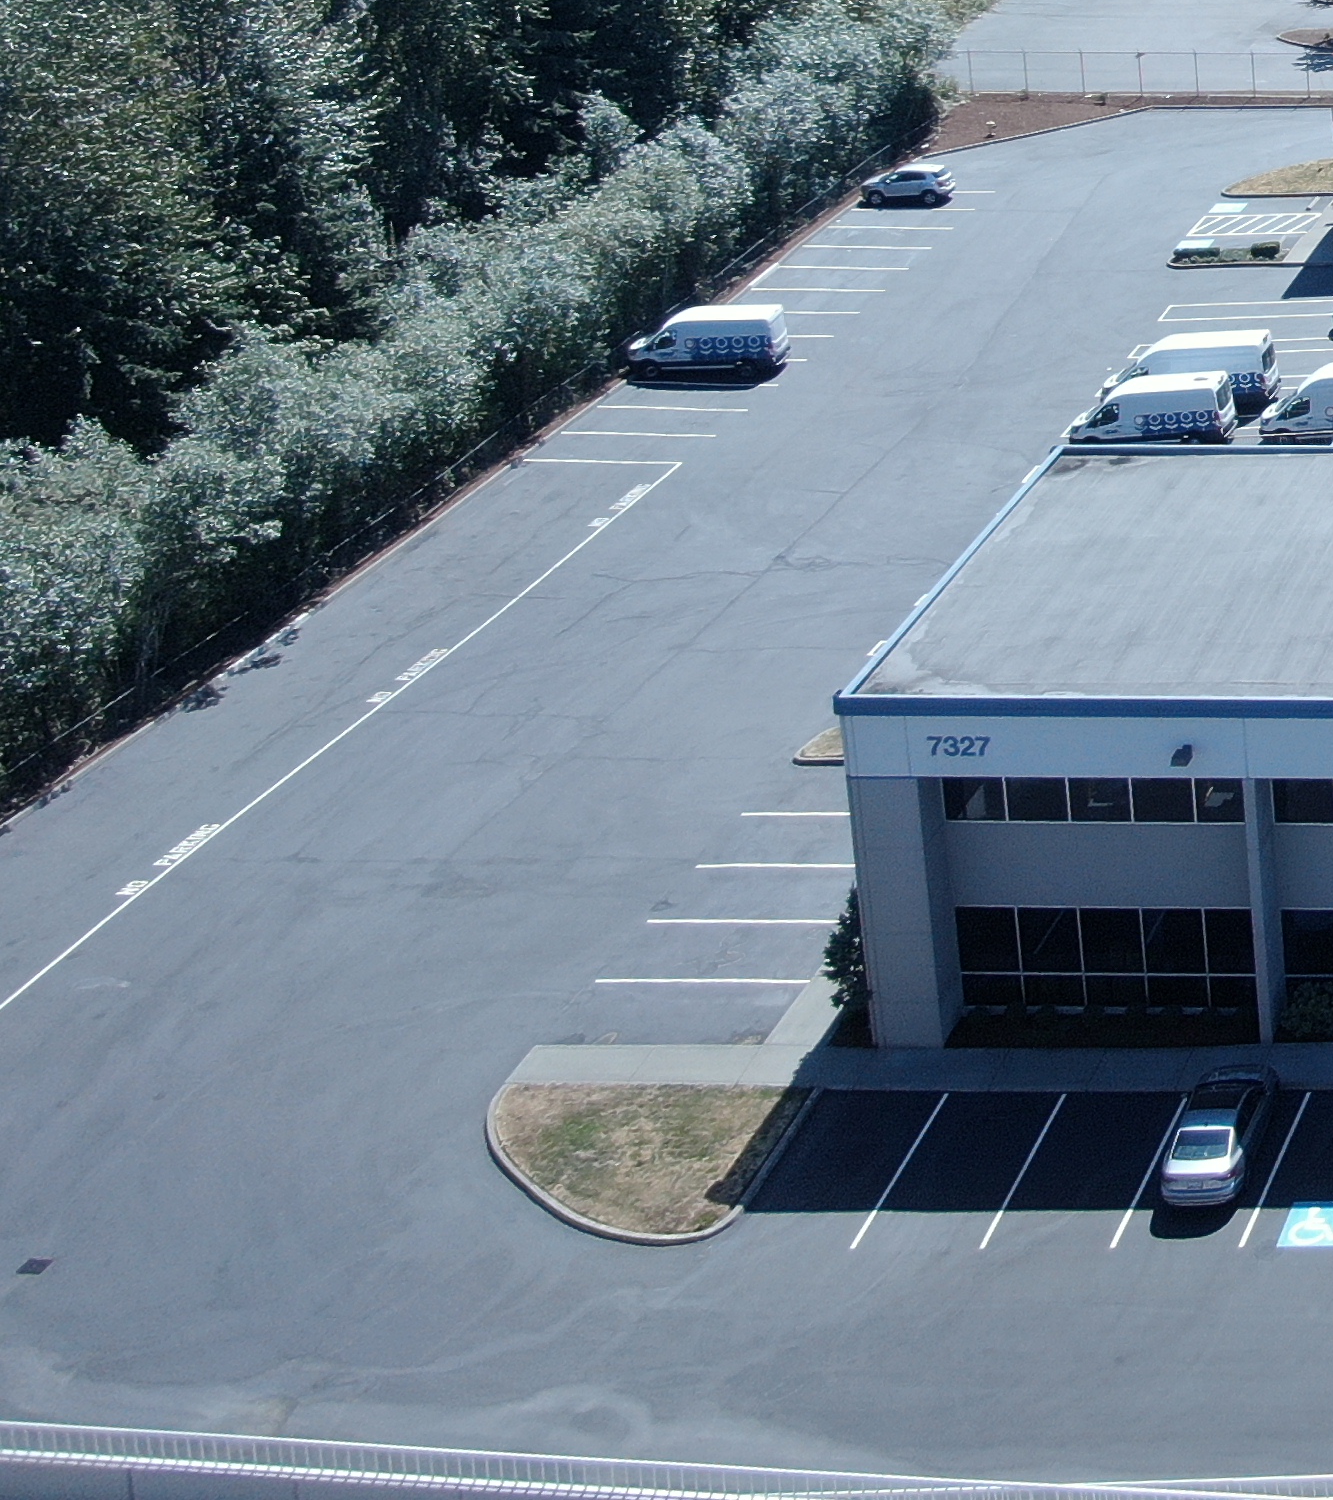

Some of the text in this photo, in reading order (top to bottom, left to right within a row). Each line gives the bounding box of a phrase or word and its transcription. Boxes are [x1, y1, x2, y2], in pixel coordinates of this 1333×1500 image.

[365, 691, 392, 703] NO
[926, 735, 991, 757] 7327
[115, 823, 221, 895] NO PARKING
